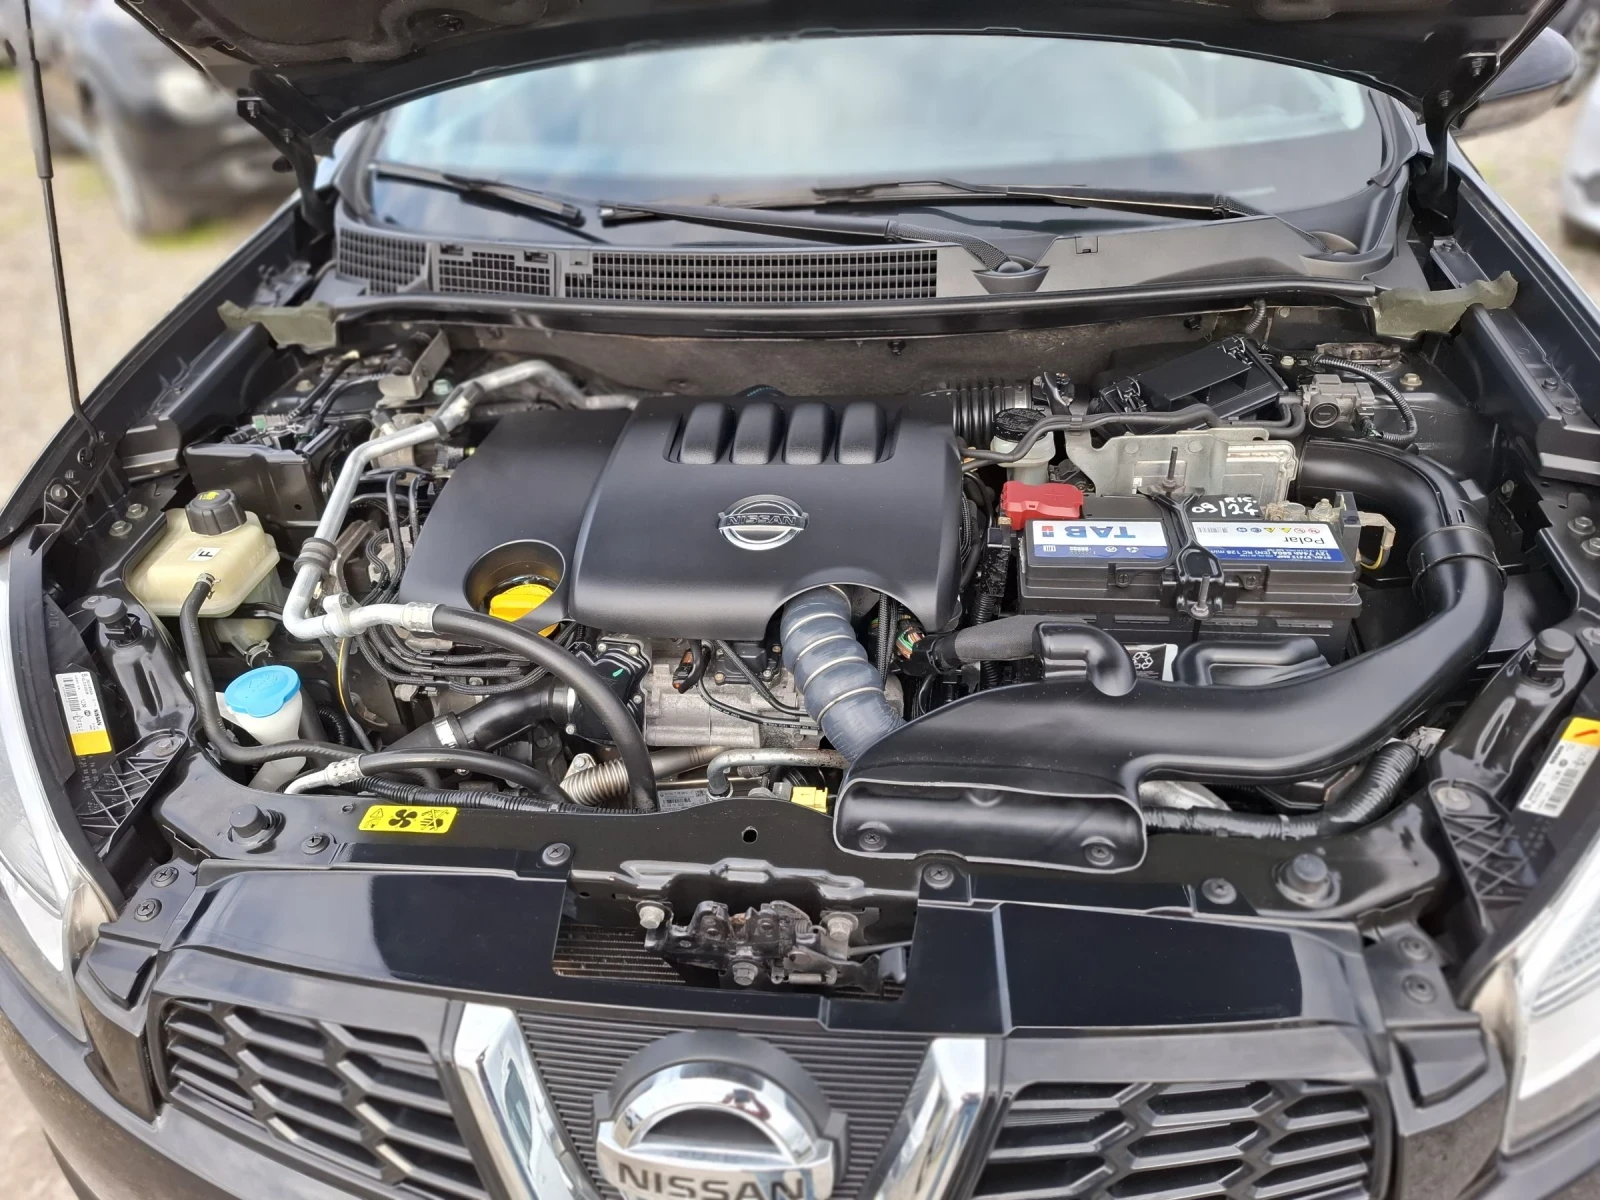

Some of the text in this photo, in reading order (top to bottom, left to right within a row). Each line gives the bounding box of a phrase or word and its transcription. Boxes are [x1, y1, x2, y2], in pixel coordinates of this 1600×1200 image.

[727, 514, 797, 525] NISSAN
[1064, 526, 1136, 538] TAB
[1284, 536, 1325, 545] Polar
[617, 1161, 804, 1200] NISSAN
